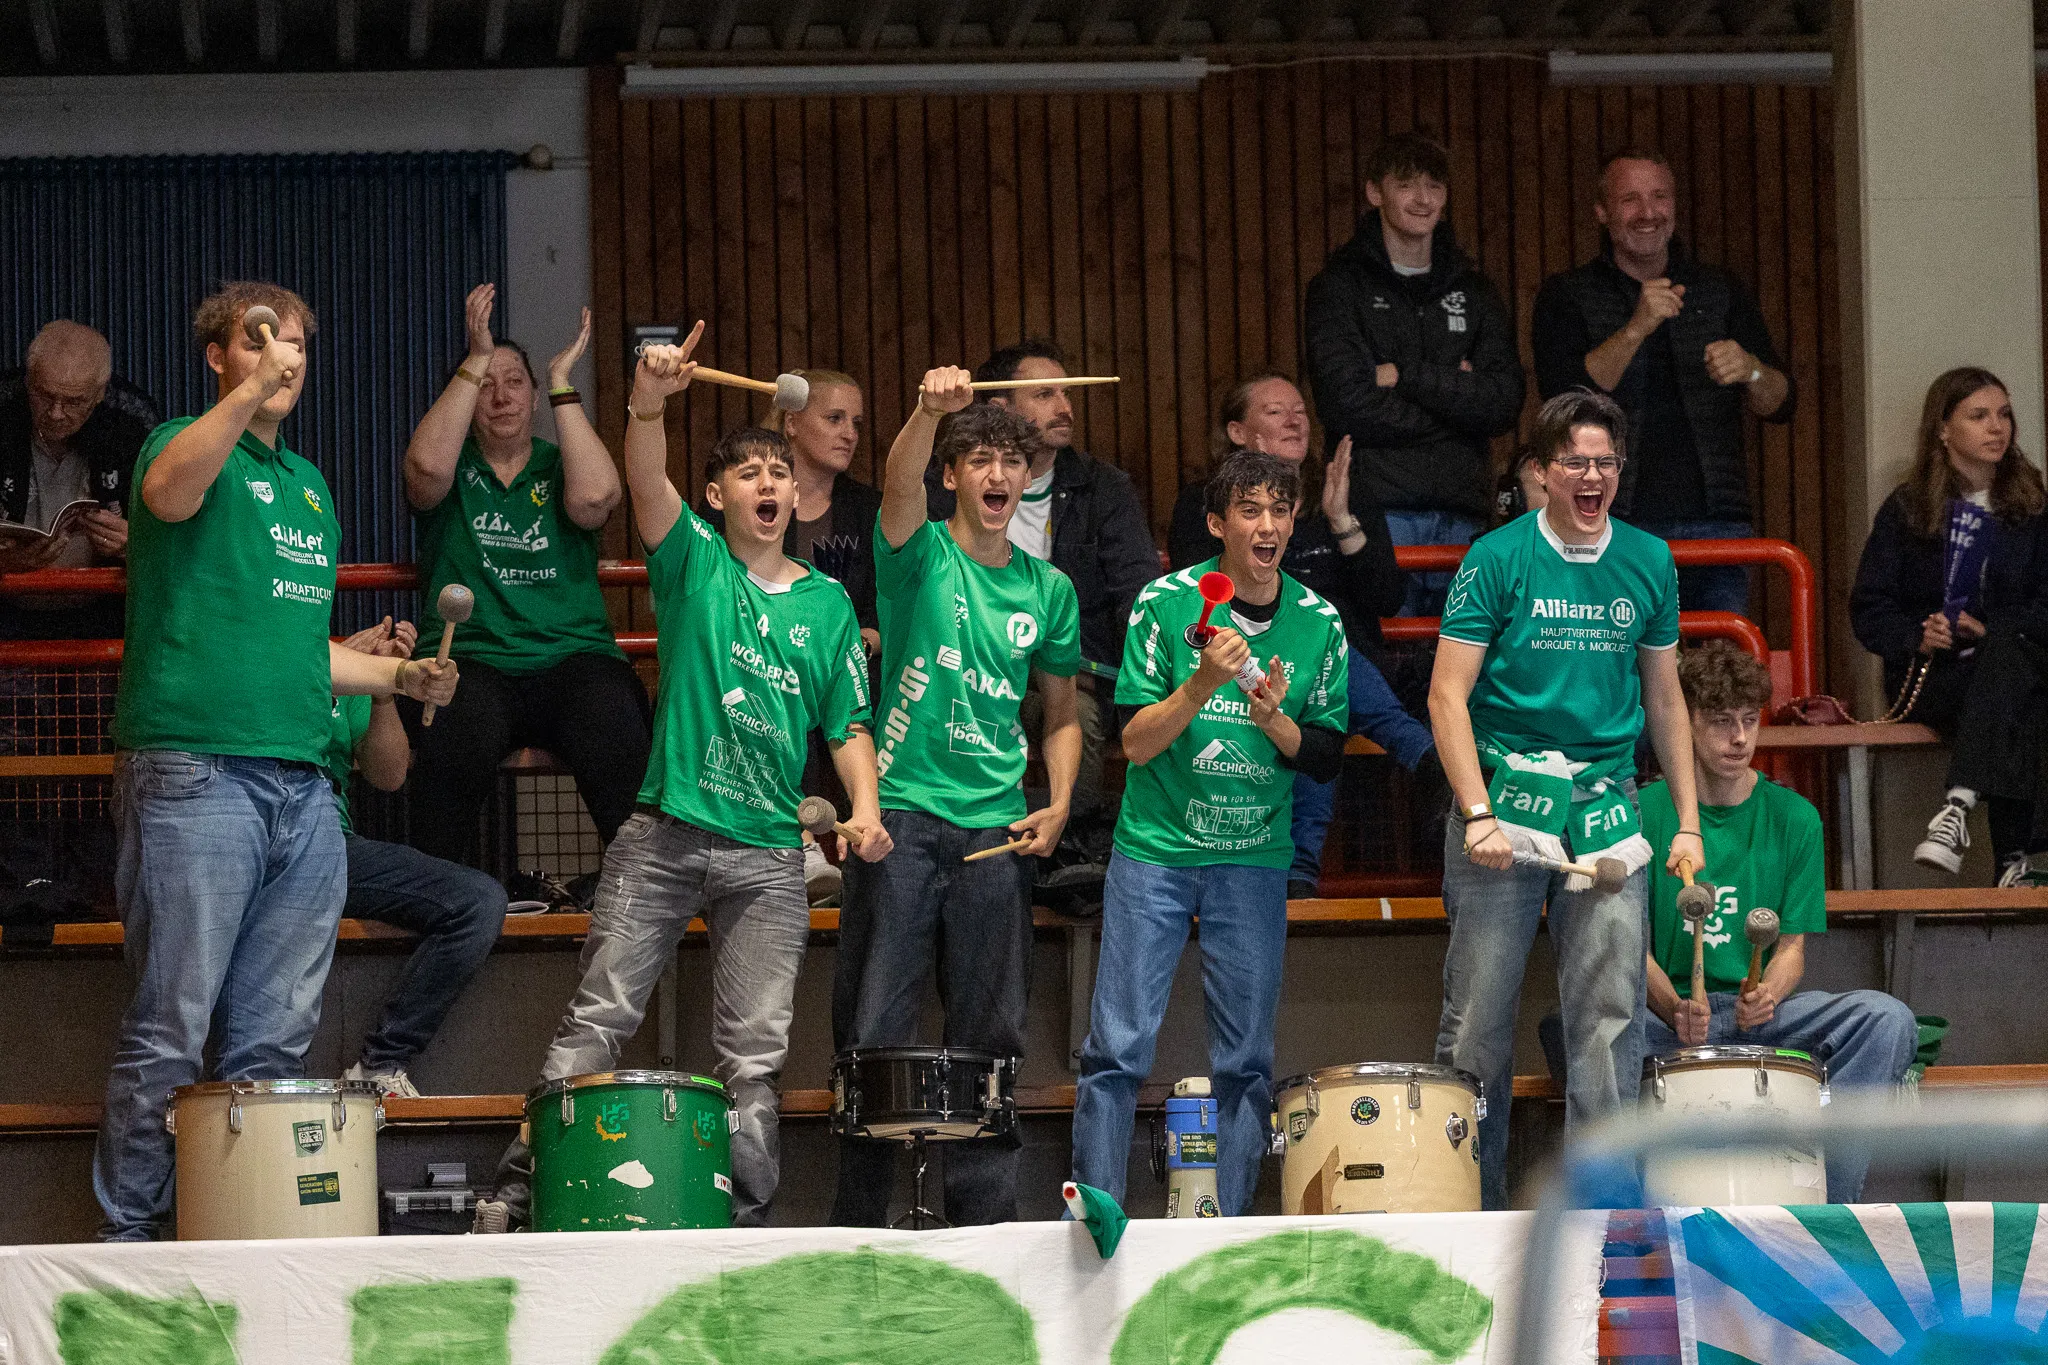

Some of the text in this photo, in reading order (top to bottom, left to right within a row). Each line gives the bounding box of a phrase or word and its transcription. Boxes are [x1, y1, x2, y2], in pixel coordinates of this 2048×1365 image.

[472, 512, 541, 544] dÄer
[493, 567, 557, 580] AFTICUS
[284, 580, 332, 601] KRAFTICUS
[1530, 598, 1605, 620] Allianz
[756, 613, 770, 638] 4
[1540, 627, 1627, 641] HAUPTVERTRETUNG
[1531, 639, 1631, 653] MORGUET & MORGUET
[731, 640, 783, 680] WÖFER
[850, 642, 870, 695] TESTZEN
[962, 667, 1020, 701] AKA
[1200, 694, 1252, 717] WÖFFL
[1199, 713, 1257, 727] VERKEHRSTECHN
[697, 777, 745, 803] MARKUS
[1496, 783, 1554, 816] Fan
[1185, 834, 1271, 851] MARKUS ZEIMET
